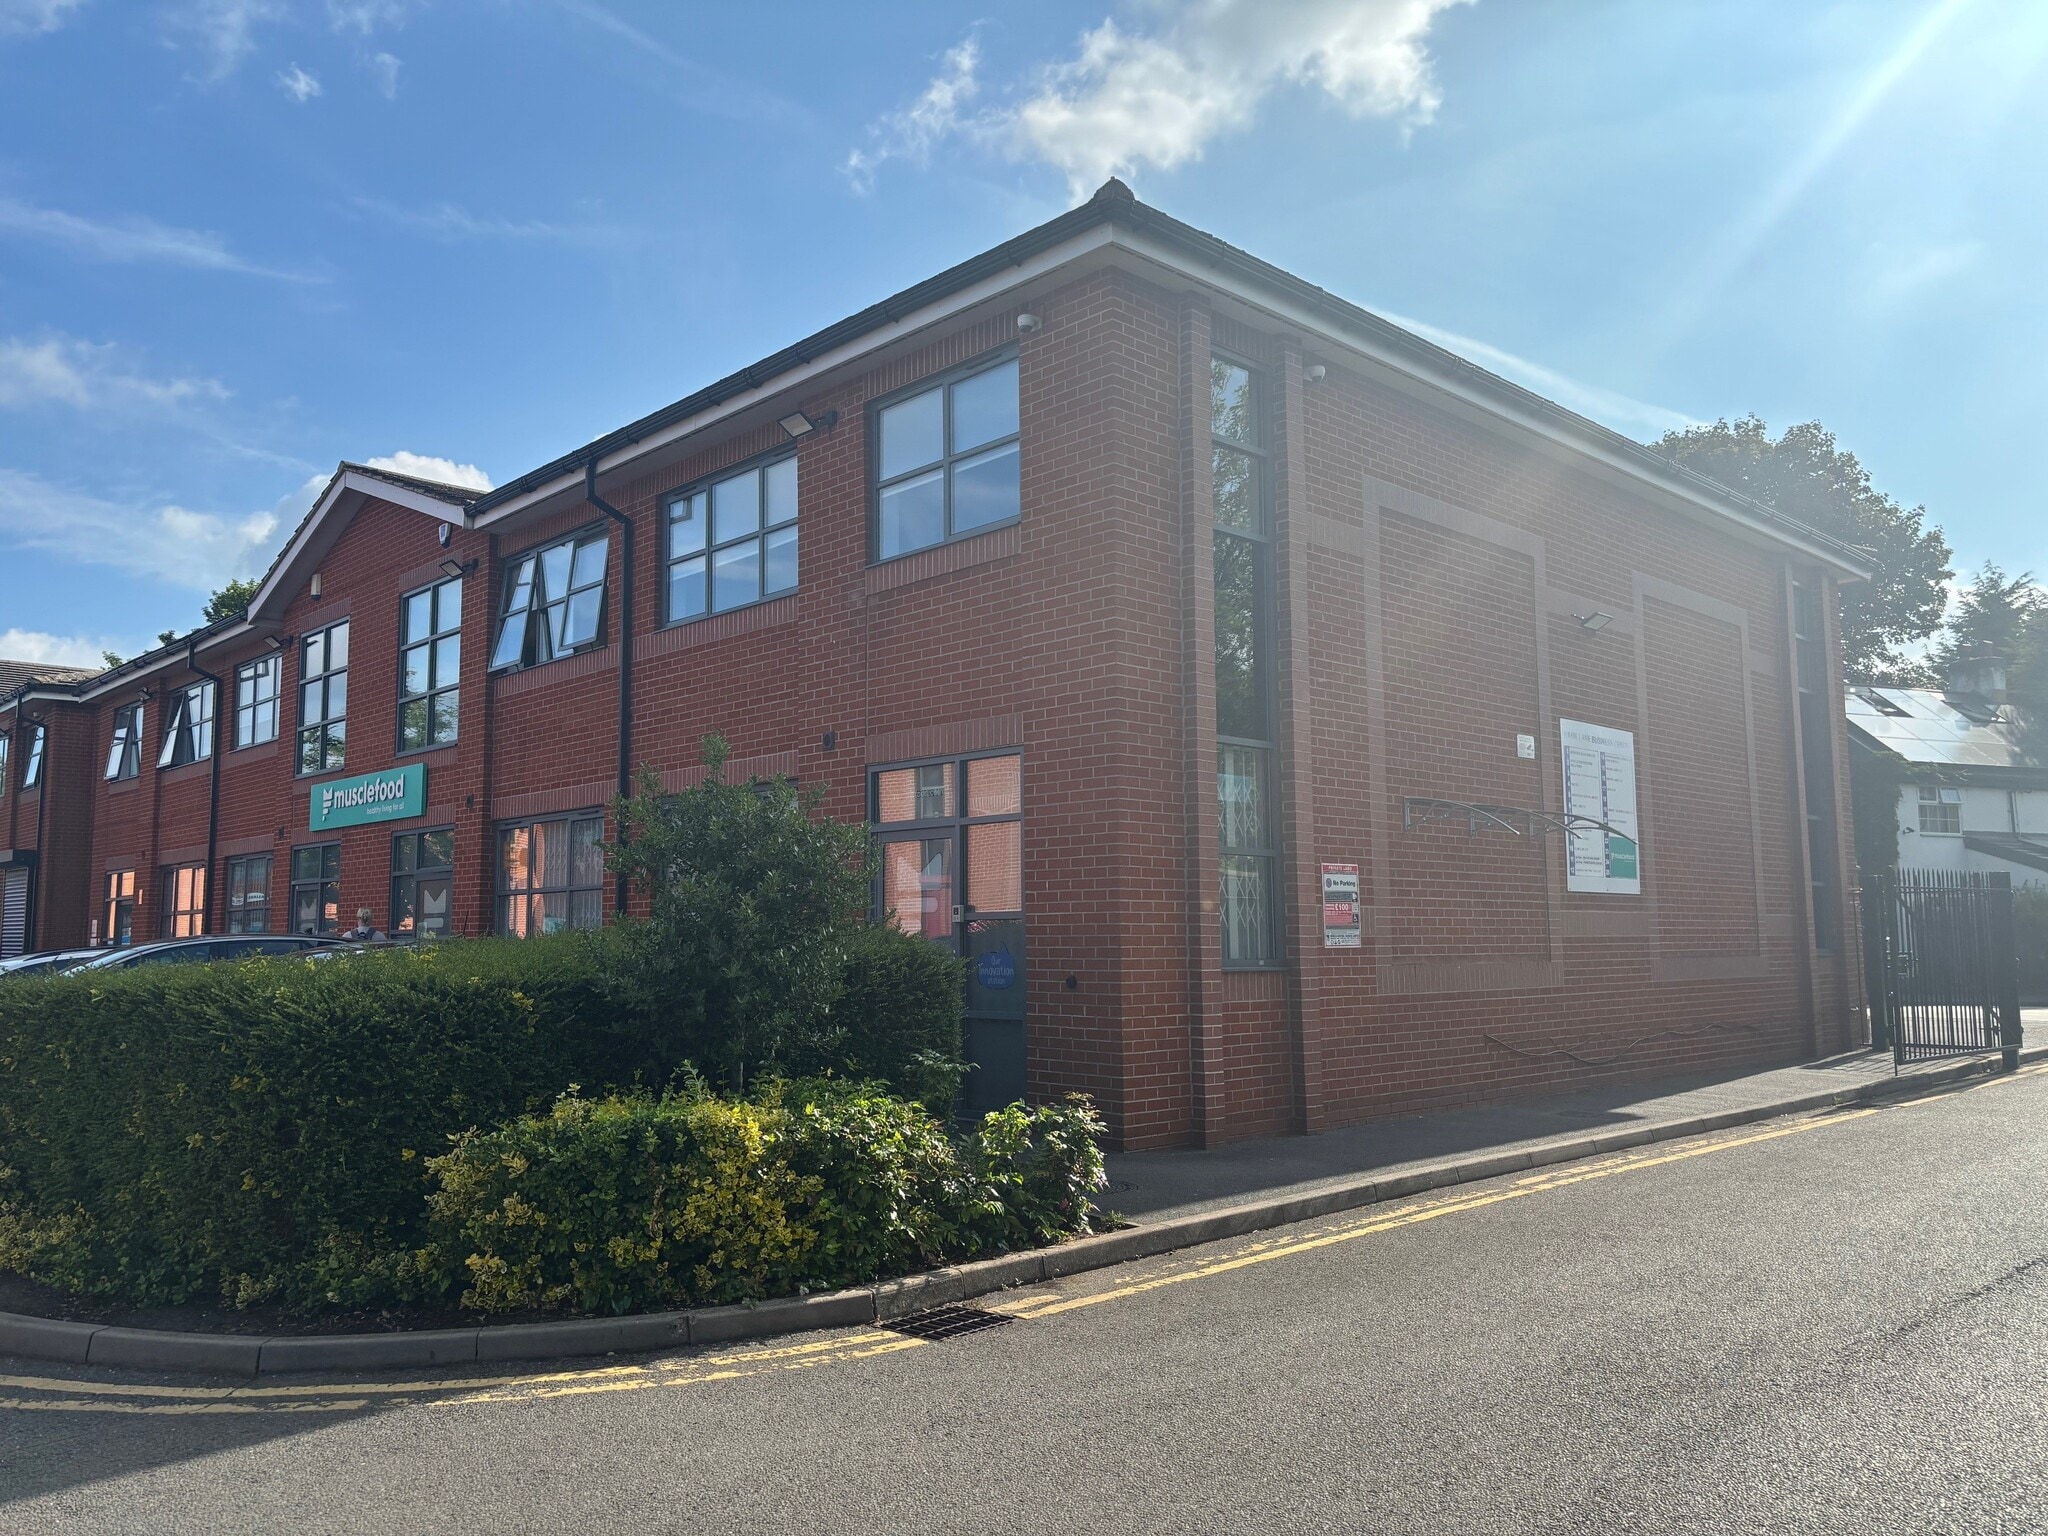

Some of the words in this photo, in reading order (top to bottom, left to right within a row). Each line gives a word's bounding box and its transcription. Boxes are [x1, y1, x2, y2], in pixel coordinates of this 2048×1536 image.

[334, 774, 404, 809] musclefood
[381, 804, 392, 813] living
[1334, 903, 1348, 911] £100
